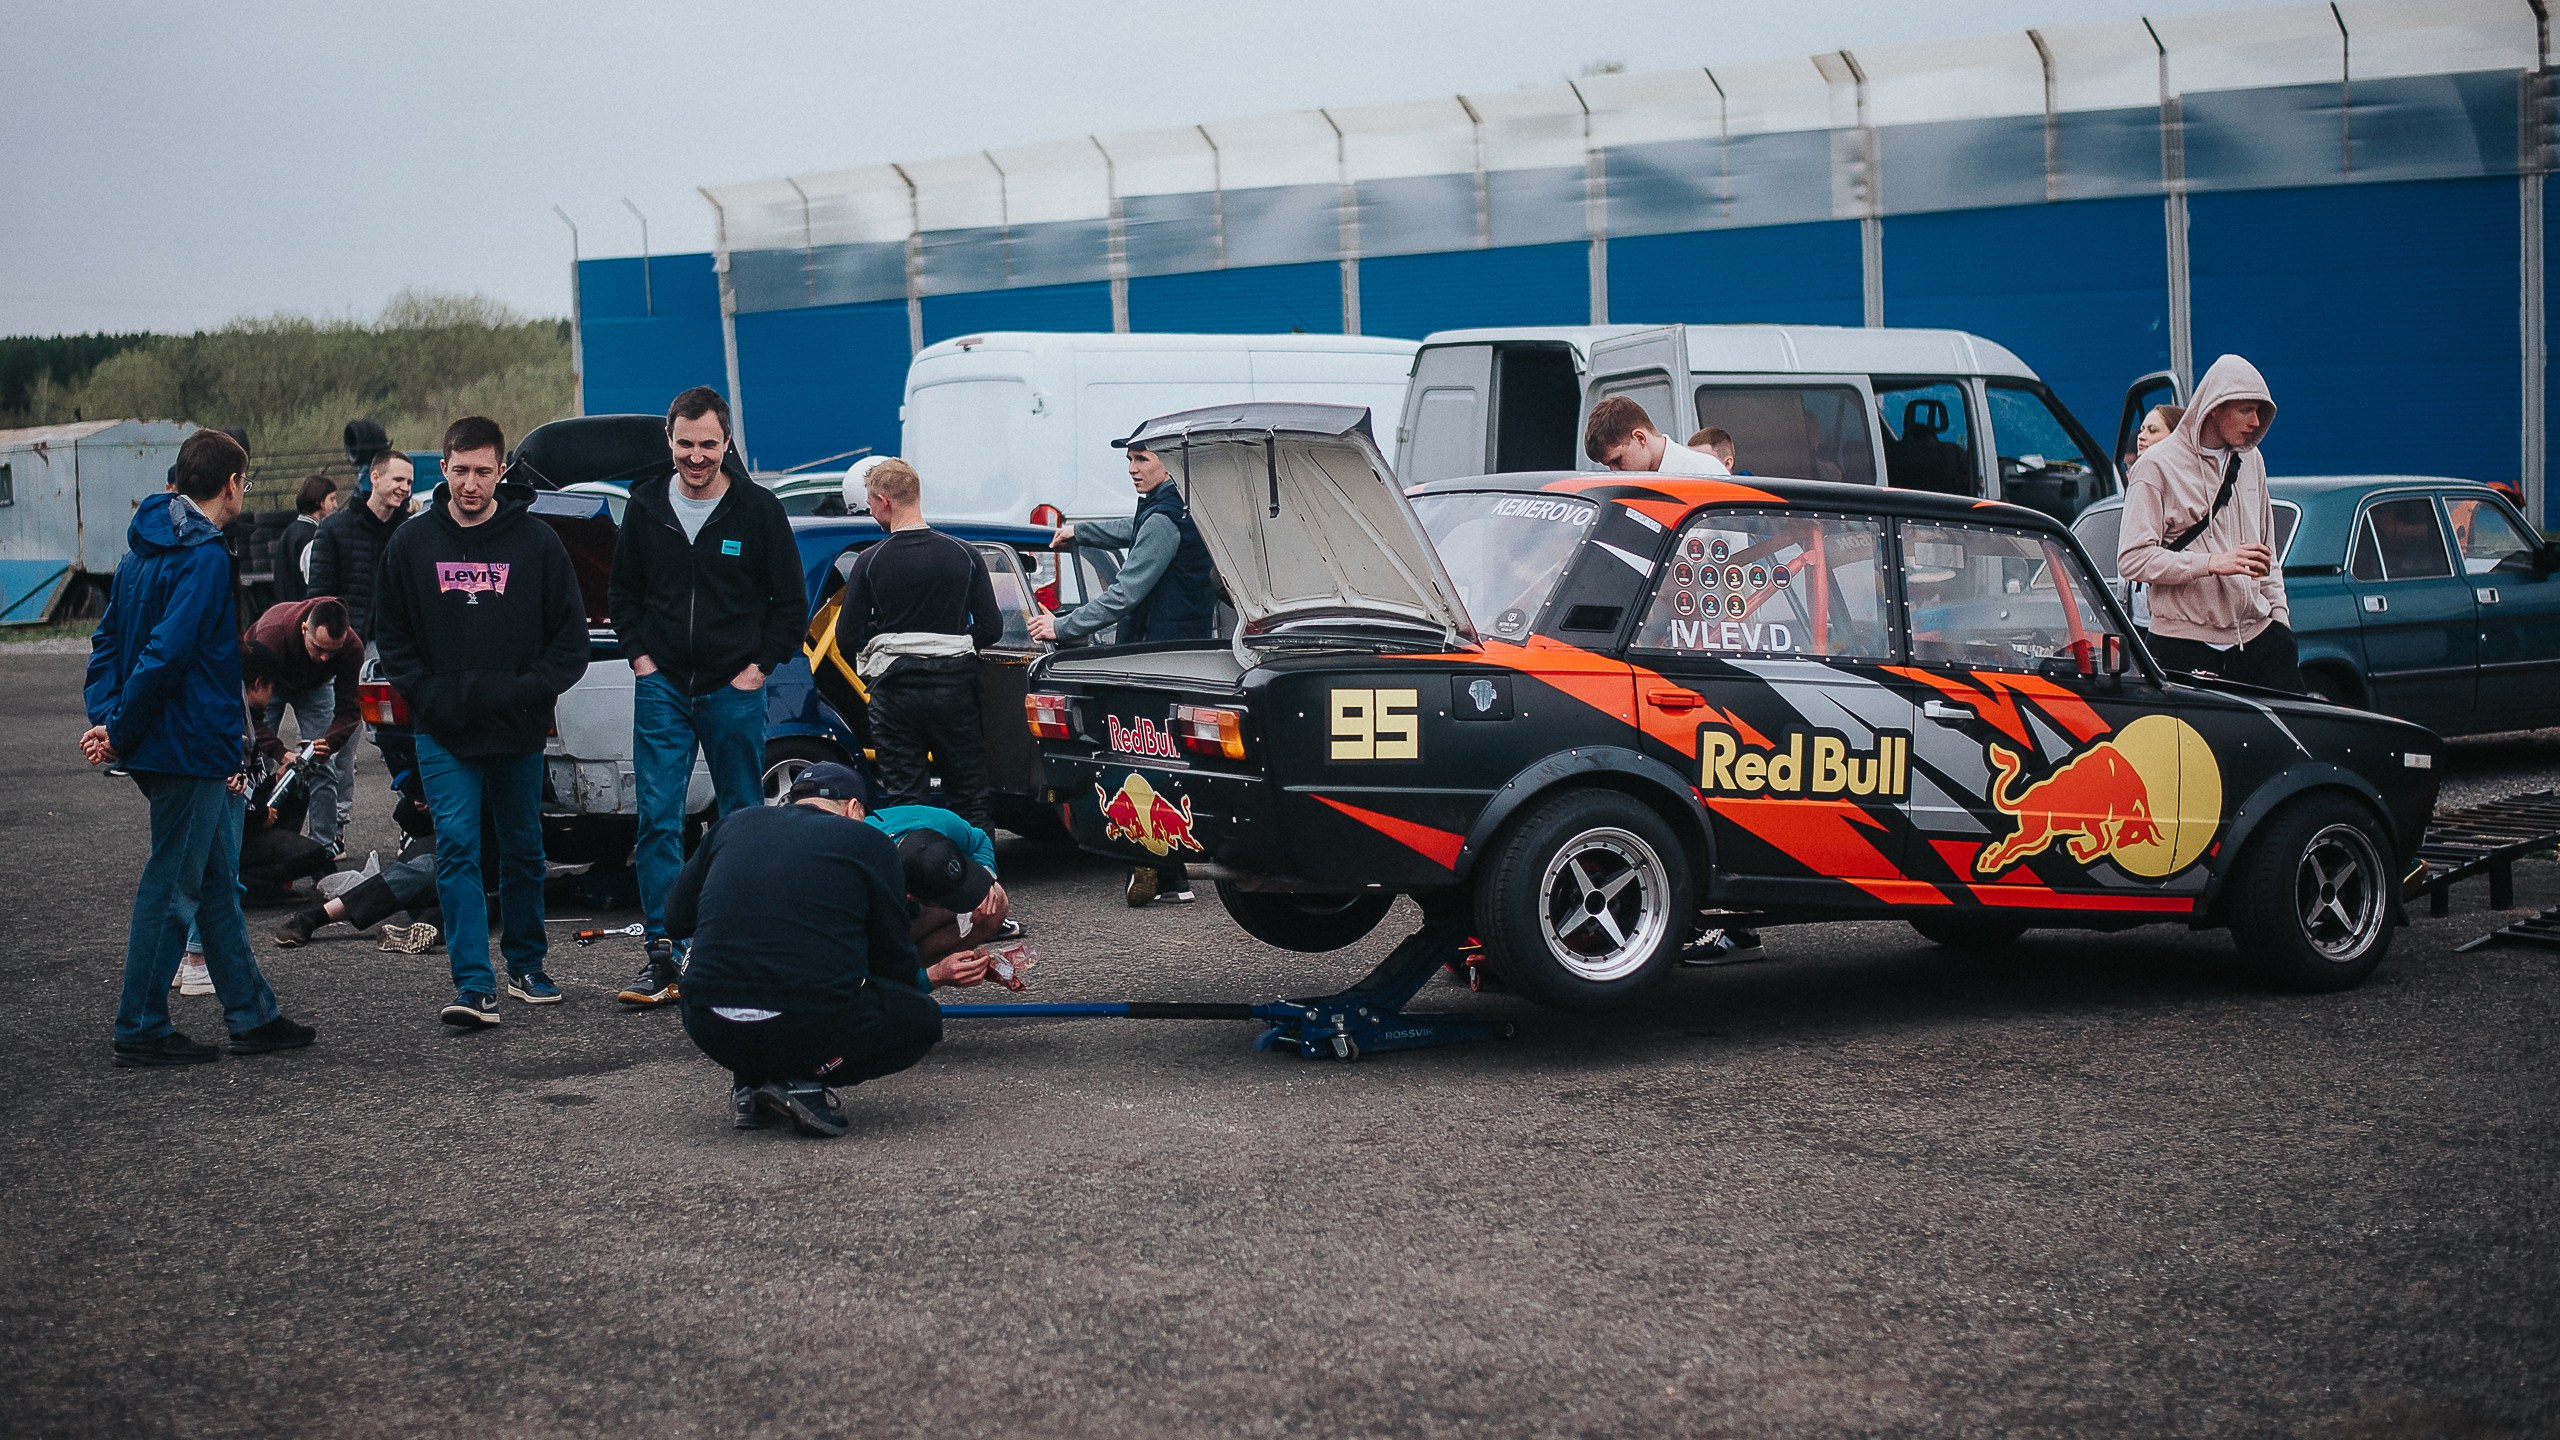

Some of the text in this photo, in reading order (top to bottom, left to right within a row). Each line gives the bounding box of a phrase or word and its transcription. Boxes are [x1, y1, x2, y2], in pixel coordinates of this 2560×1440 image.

[1491, 498, 1595, 526] KEMEROVO
[1108, 714, 1180, 758] Red Bul
[1331, 688, 1419, 760] 95
[1701, 731, 1906, 795] Red Bull
[1385, 1029, 1434, 1040] ROSSVIK
